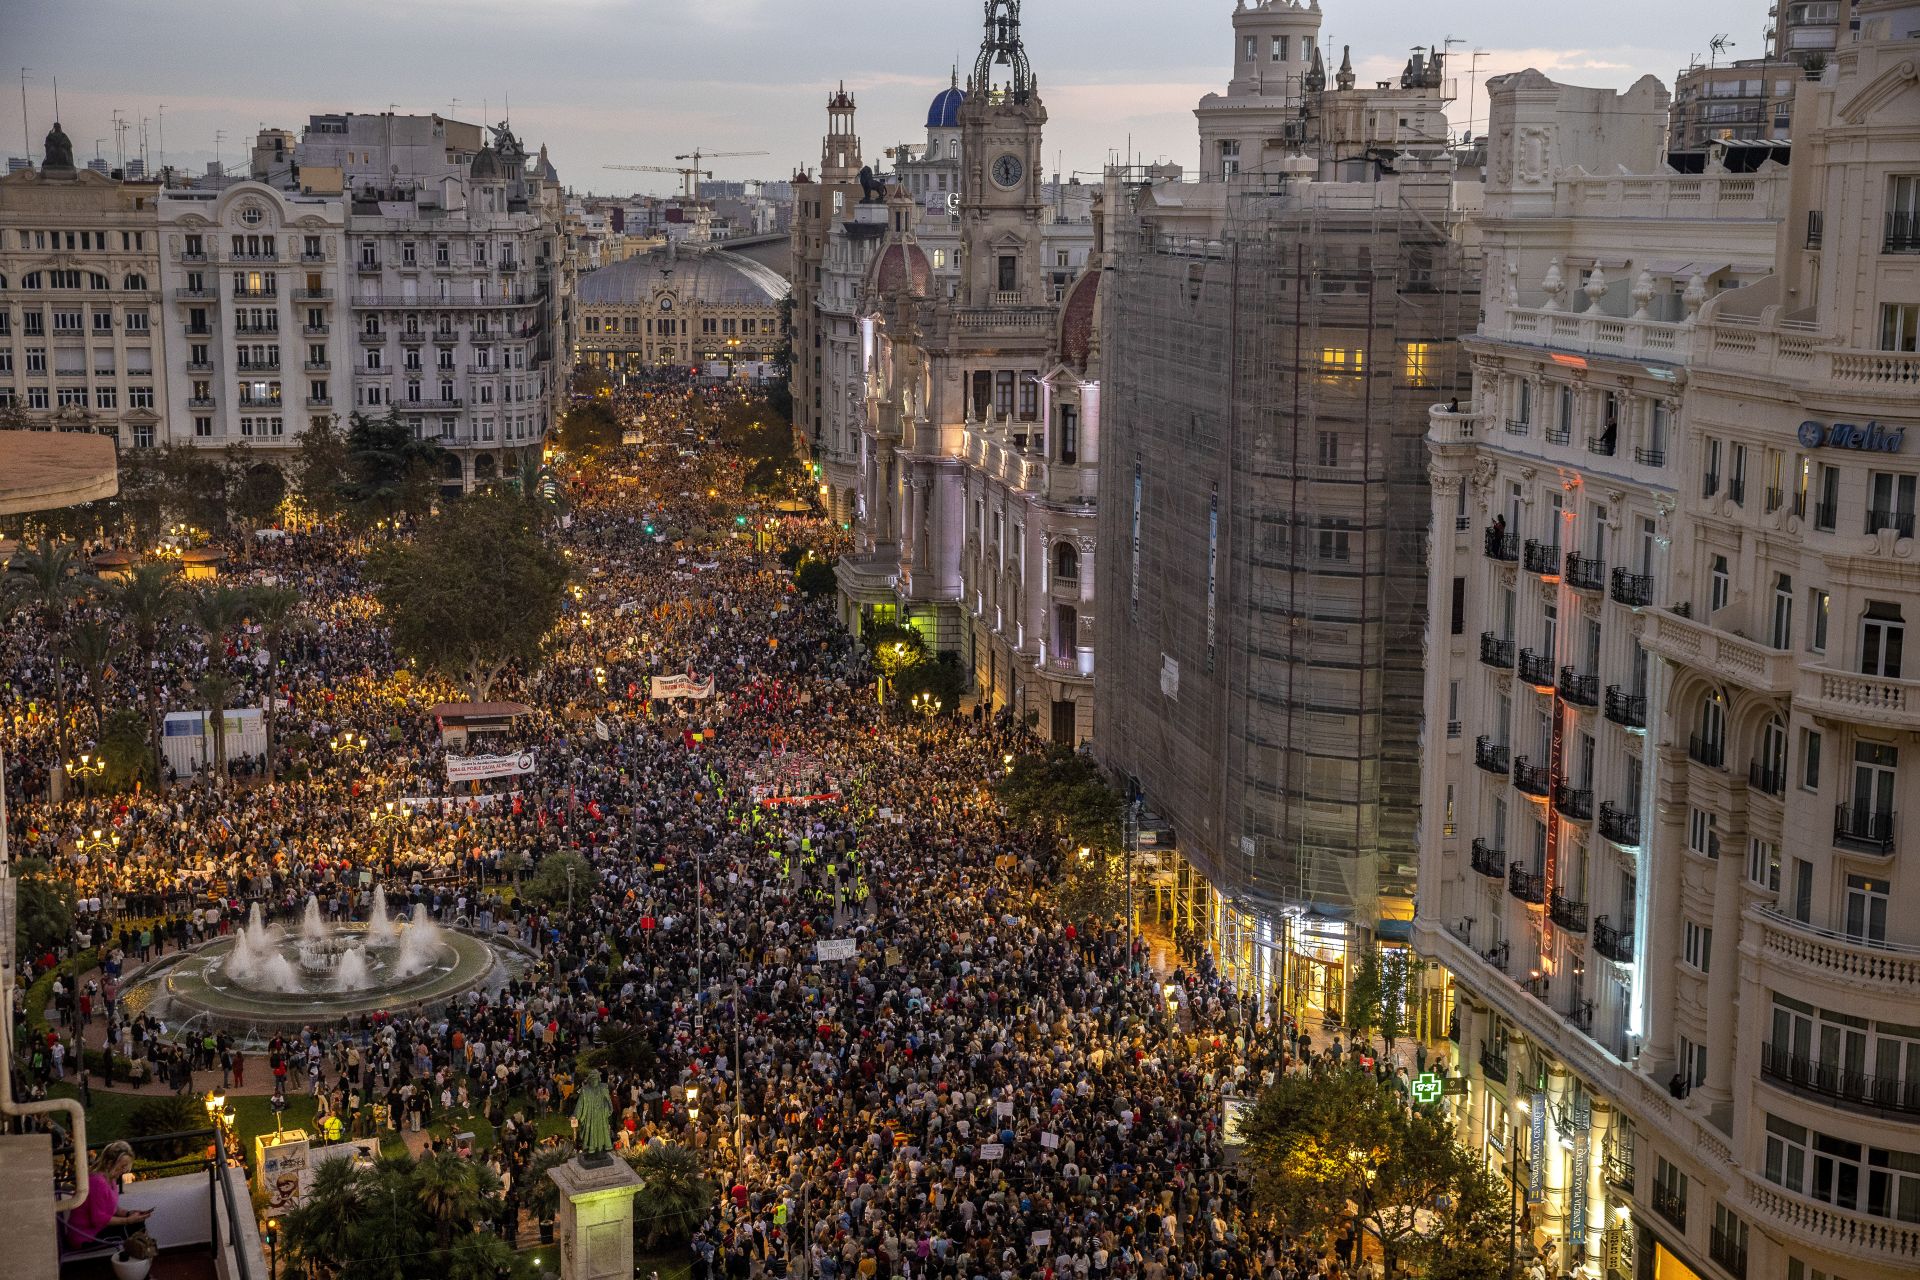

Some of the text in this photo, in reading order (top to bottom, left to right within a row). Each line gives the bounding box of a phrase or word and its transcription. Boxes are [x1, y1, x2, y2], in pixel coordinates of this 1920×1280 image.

[1531, 1112, 1544, 1188] VENECIA PLAZA CENTRO
[1573, 1148, 1587, 1228] VENECIA PLAZA CENTRO
